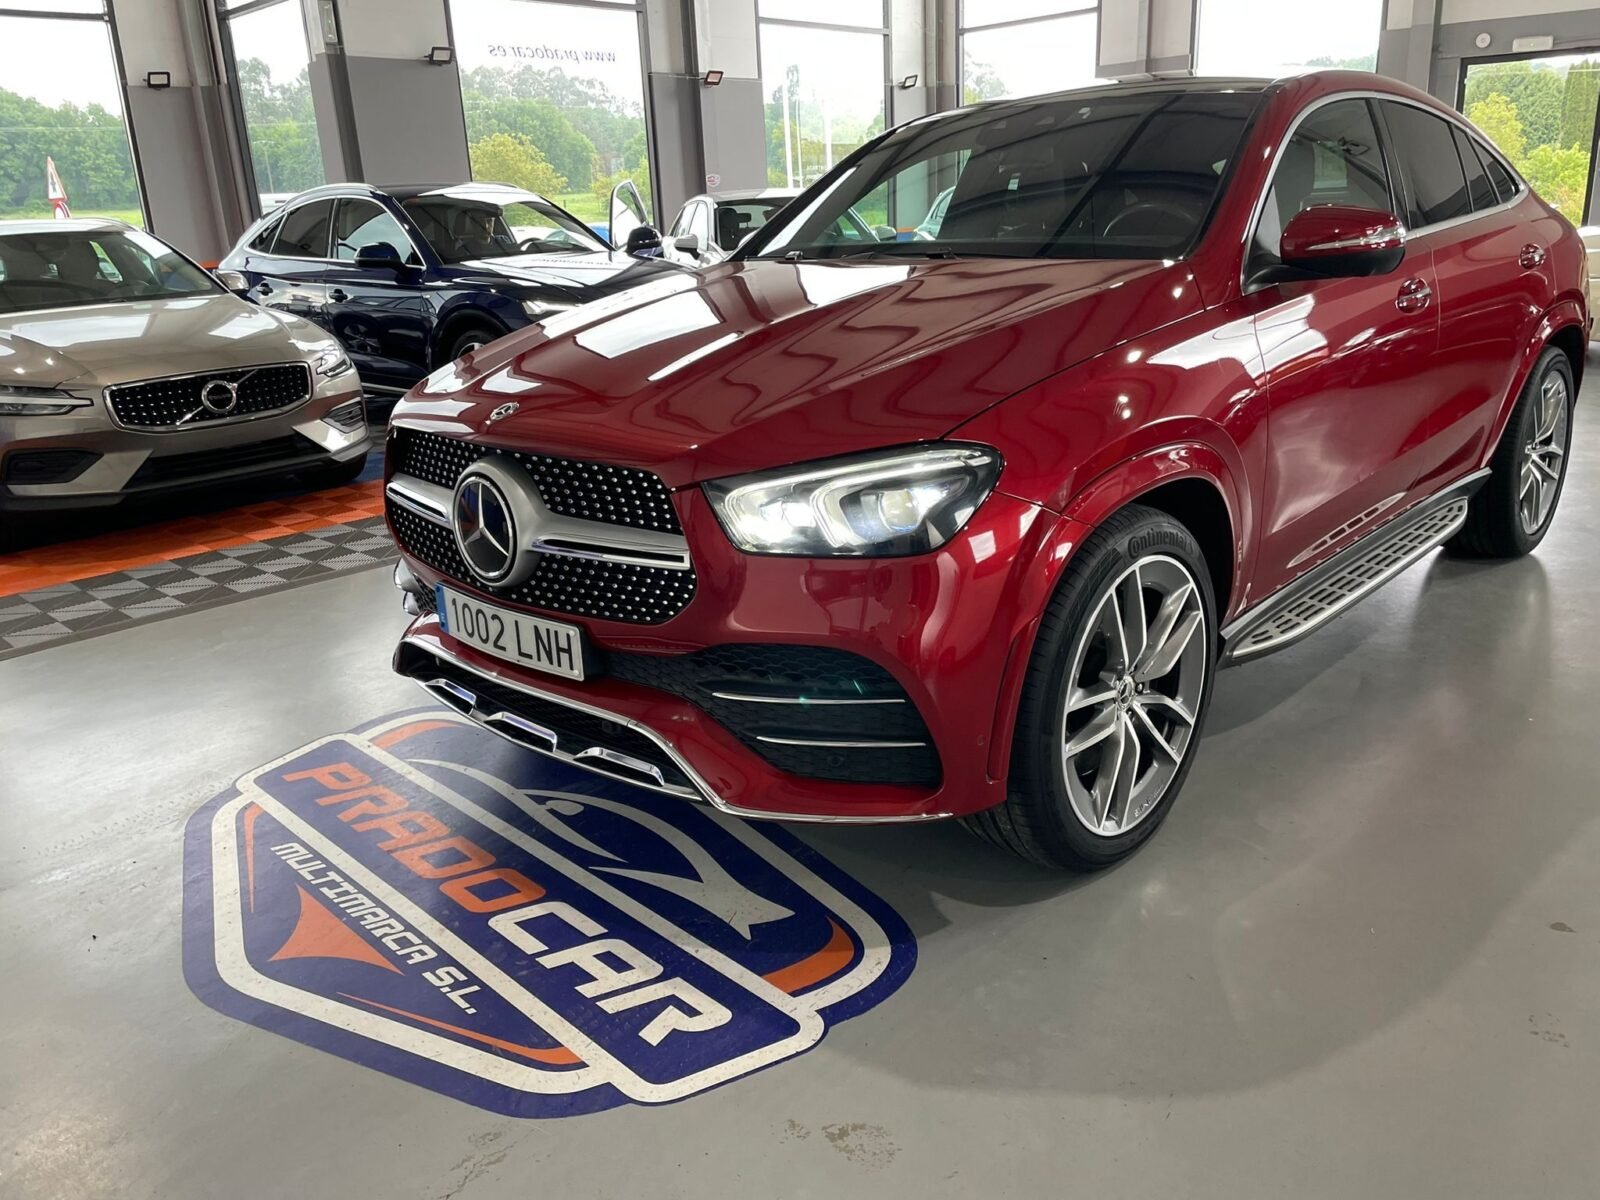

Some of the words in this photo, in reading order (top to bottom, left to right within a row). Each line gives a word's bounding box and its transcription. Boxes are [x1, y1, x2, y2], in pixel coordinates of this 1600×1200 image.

[1127, 528, 1187, 559] Continental
[452, 598, 507, 652] 1002
[515, 620, 574, 671] LNH
[271, 842, 438, 965] MULTIMARCA
[421, 966, 481, 1015] S.L.
[282, 762, 733, 1047] PRADOCAR
